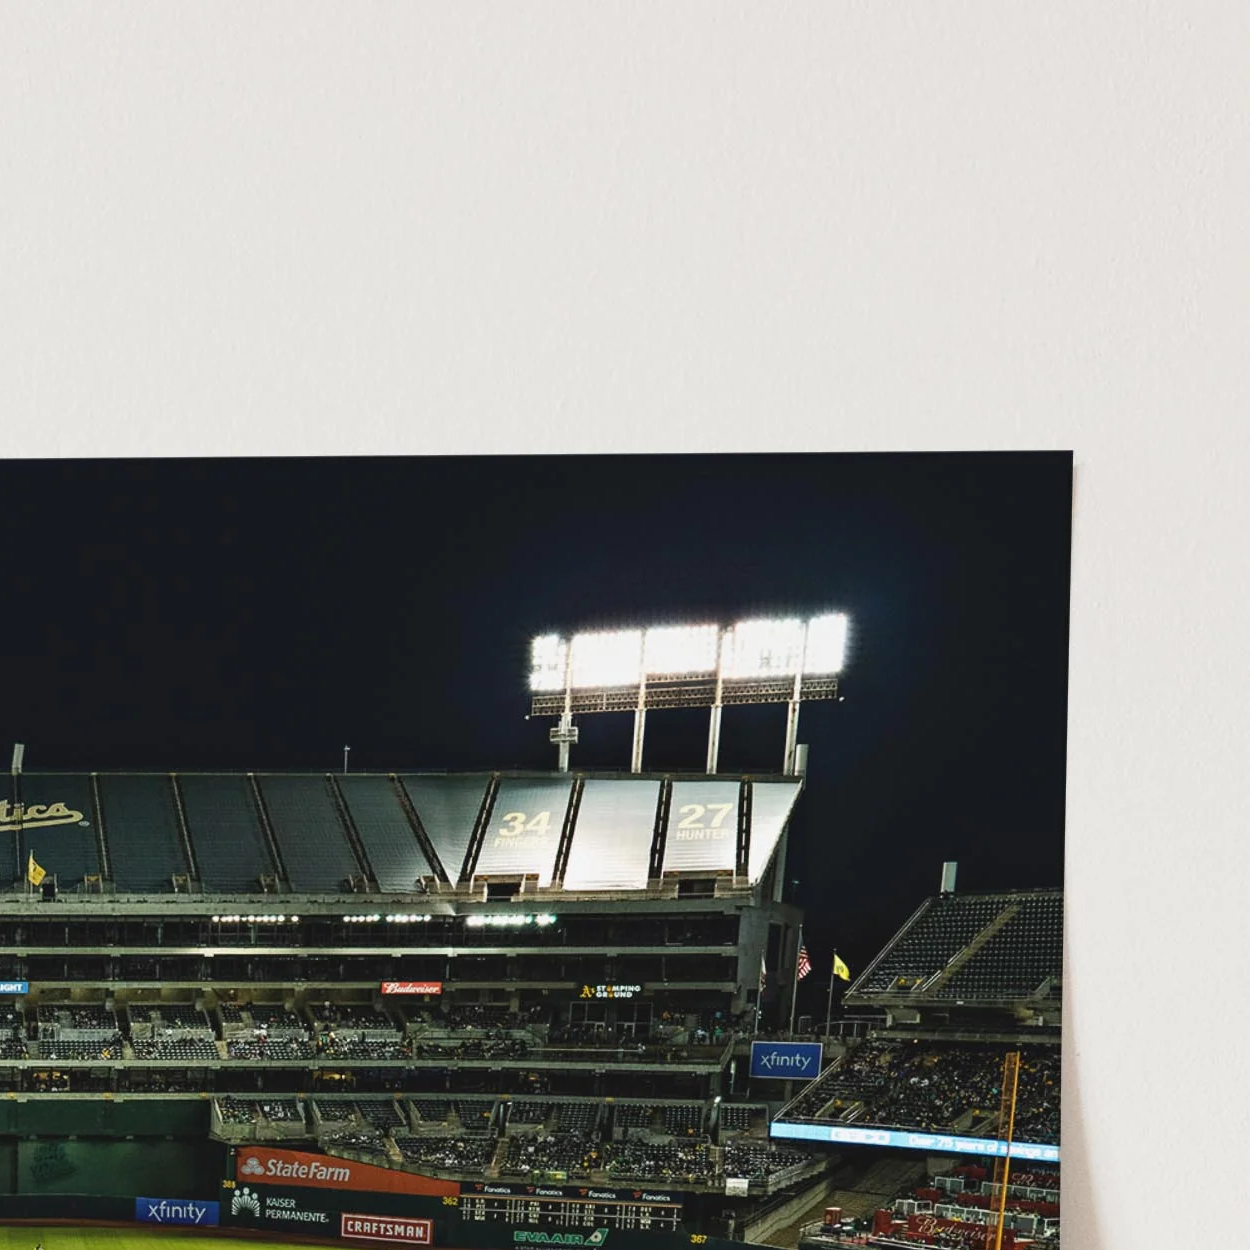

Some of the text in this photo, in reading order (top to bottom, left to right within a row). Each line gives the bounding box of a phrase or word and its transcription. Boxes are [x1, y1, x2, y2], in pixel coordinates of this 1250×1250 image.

[678, 803, 734, 829] 27
[499, 811, 551, 837] 34
[676, 828, 730, 841] HUNTER
[383, 982, 440, 994] Budweiser
[760, 1052, 812, 1070] xfinity
[484, 1185, 511, 1194] Fanatics
[535, 1187, 563, 1197] Fanatics
[588, 1190, 617, 1199] Fanatics
[266, 1197, 296, 1209] KAISER
[442, 1196, 458, 1207] 362
[642, 1193, 671, 1202] Fanatics
[148, 1202, 207, 1222] xfinity
[347, 1220, 425, 1238] CRAFTSMAN
[690, 1233, 707, 1244] 367
